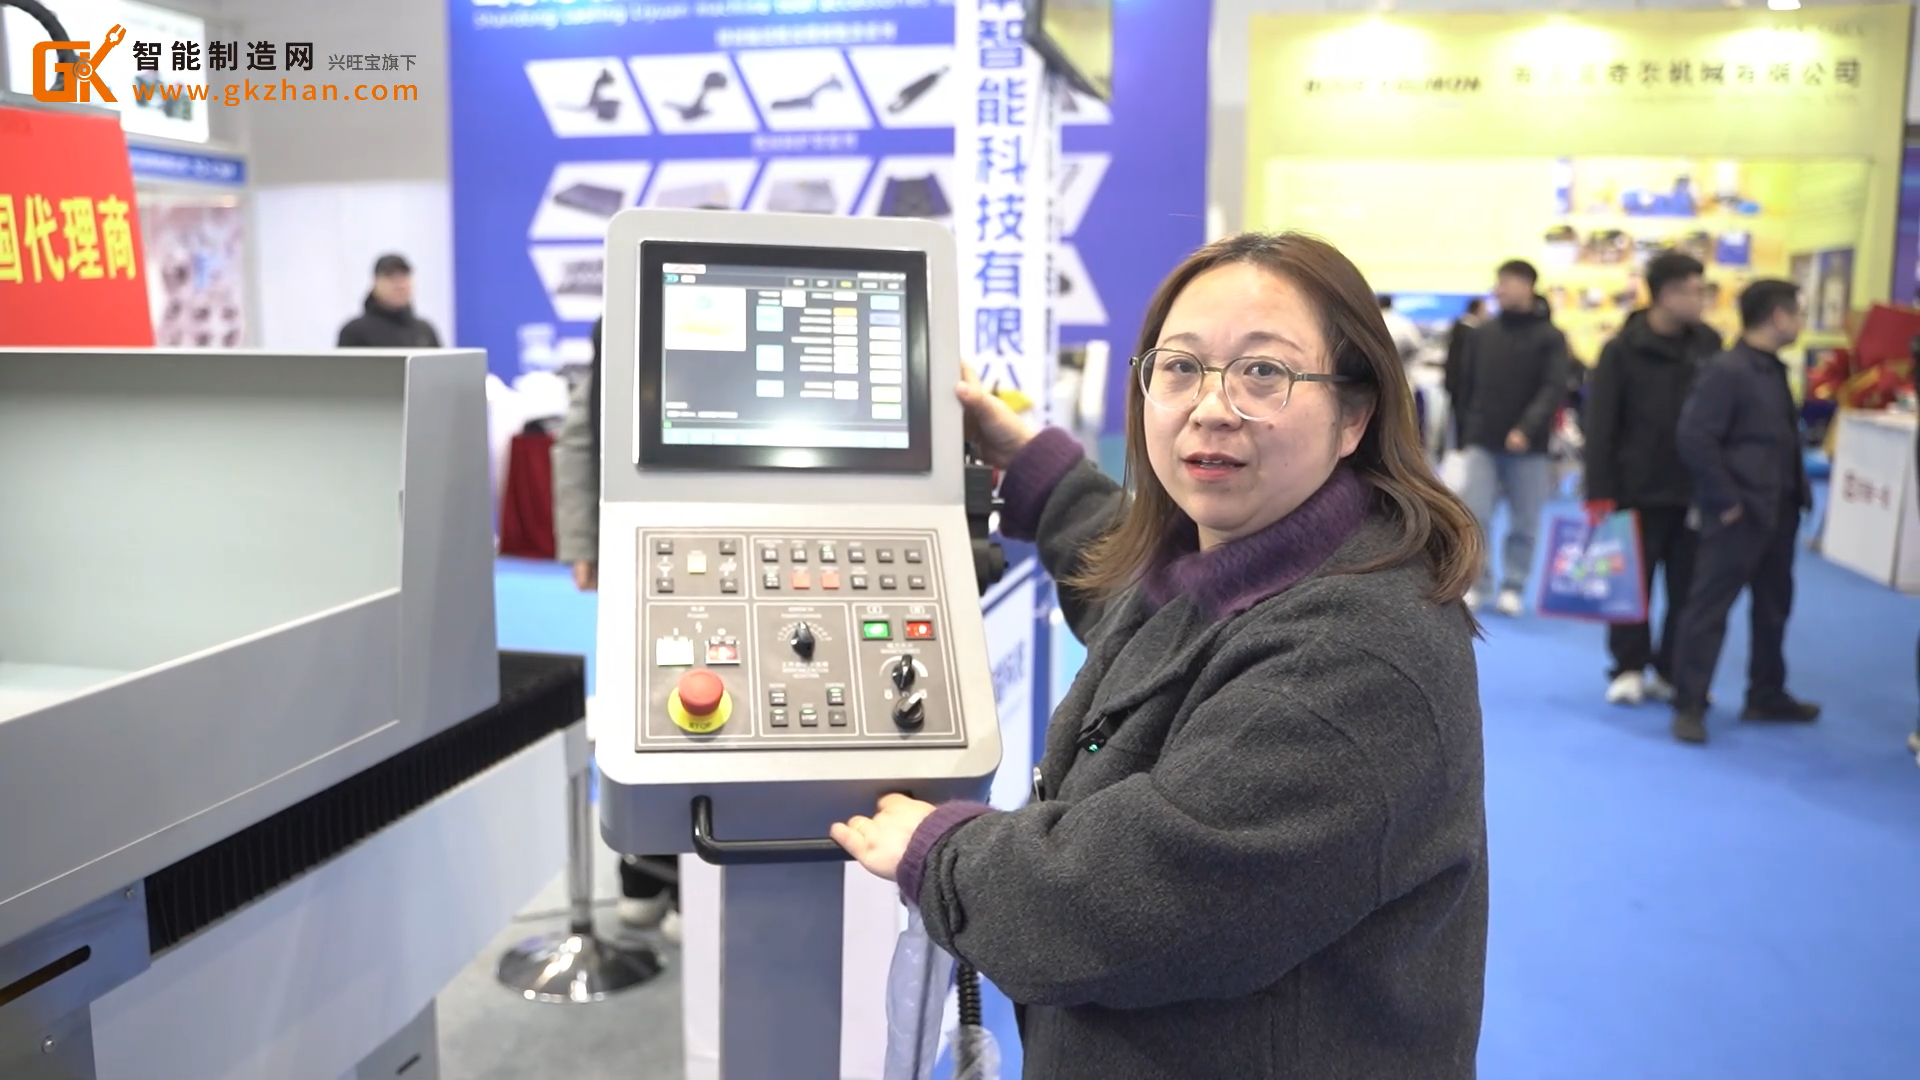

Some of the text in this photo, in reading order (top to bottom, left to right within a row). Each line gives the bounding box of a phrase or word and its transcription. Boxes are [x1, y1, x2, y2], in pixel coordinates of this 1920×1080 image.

[0, 194, 137, 284] 国代理商
[975, 0, 1028, 390] 智能科技有限公
